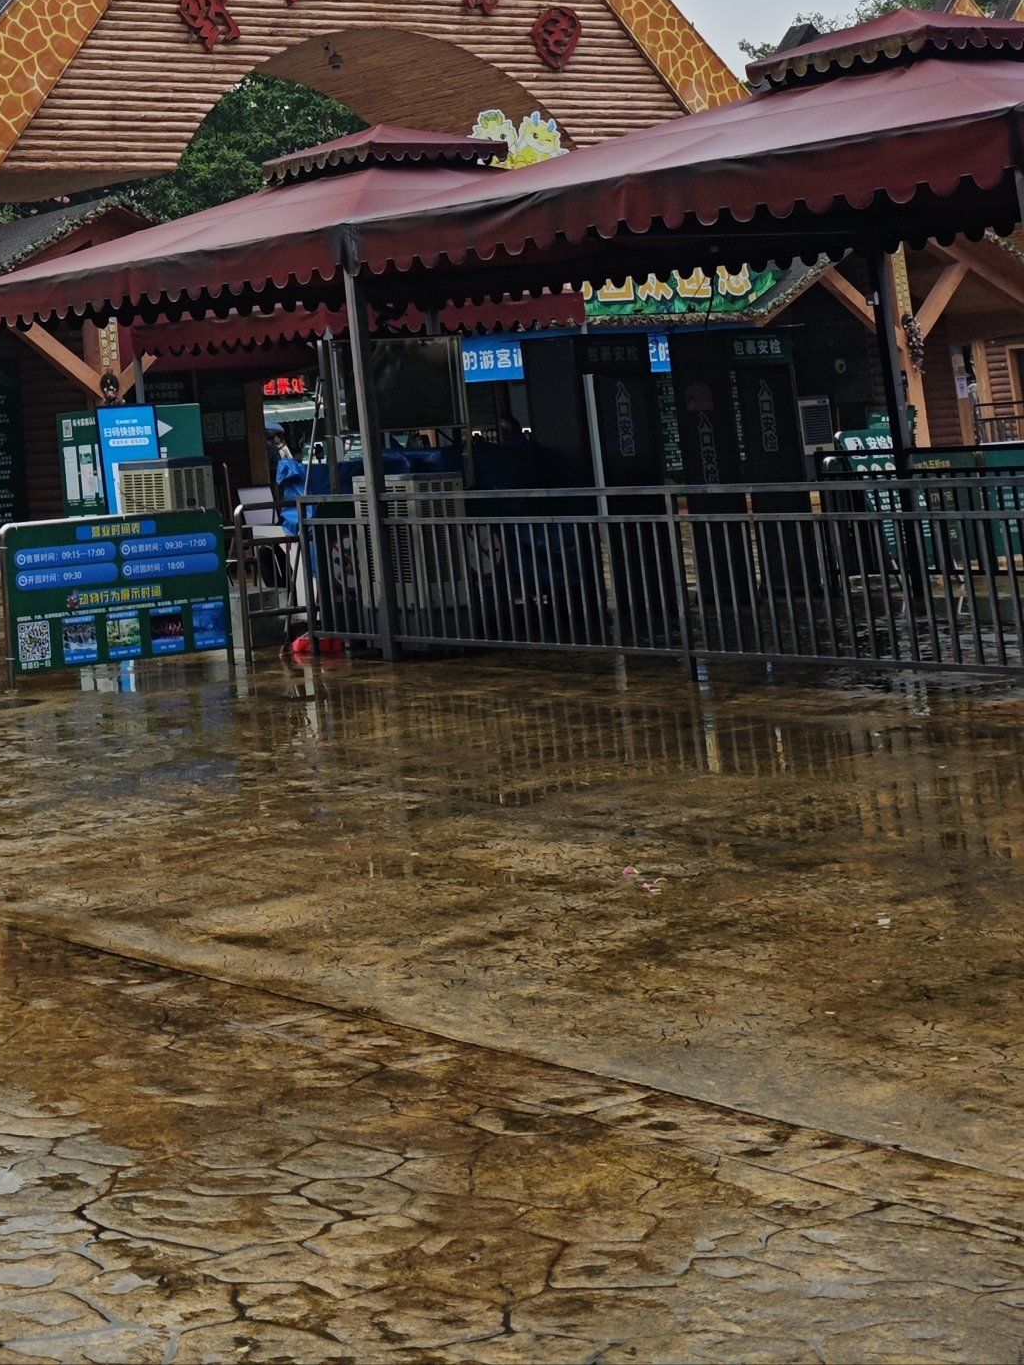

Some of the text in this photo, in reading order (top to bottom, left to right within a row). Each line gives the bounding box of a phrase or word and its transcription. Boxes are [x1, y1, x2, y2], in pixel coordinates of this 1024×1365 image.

[586, 345, 640, 363] 包裹安检
[733, 339, 782, 355] 包裹安检
[615, 380, 636, 457] 入口安检
[757, 378, 779, 452] 入口安检
[79, 585, 162, 606] 动物行为展示时间
